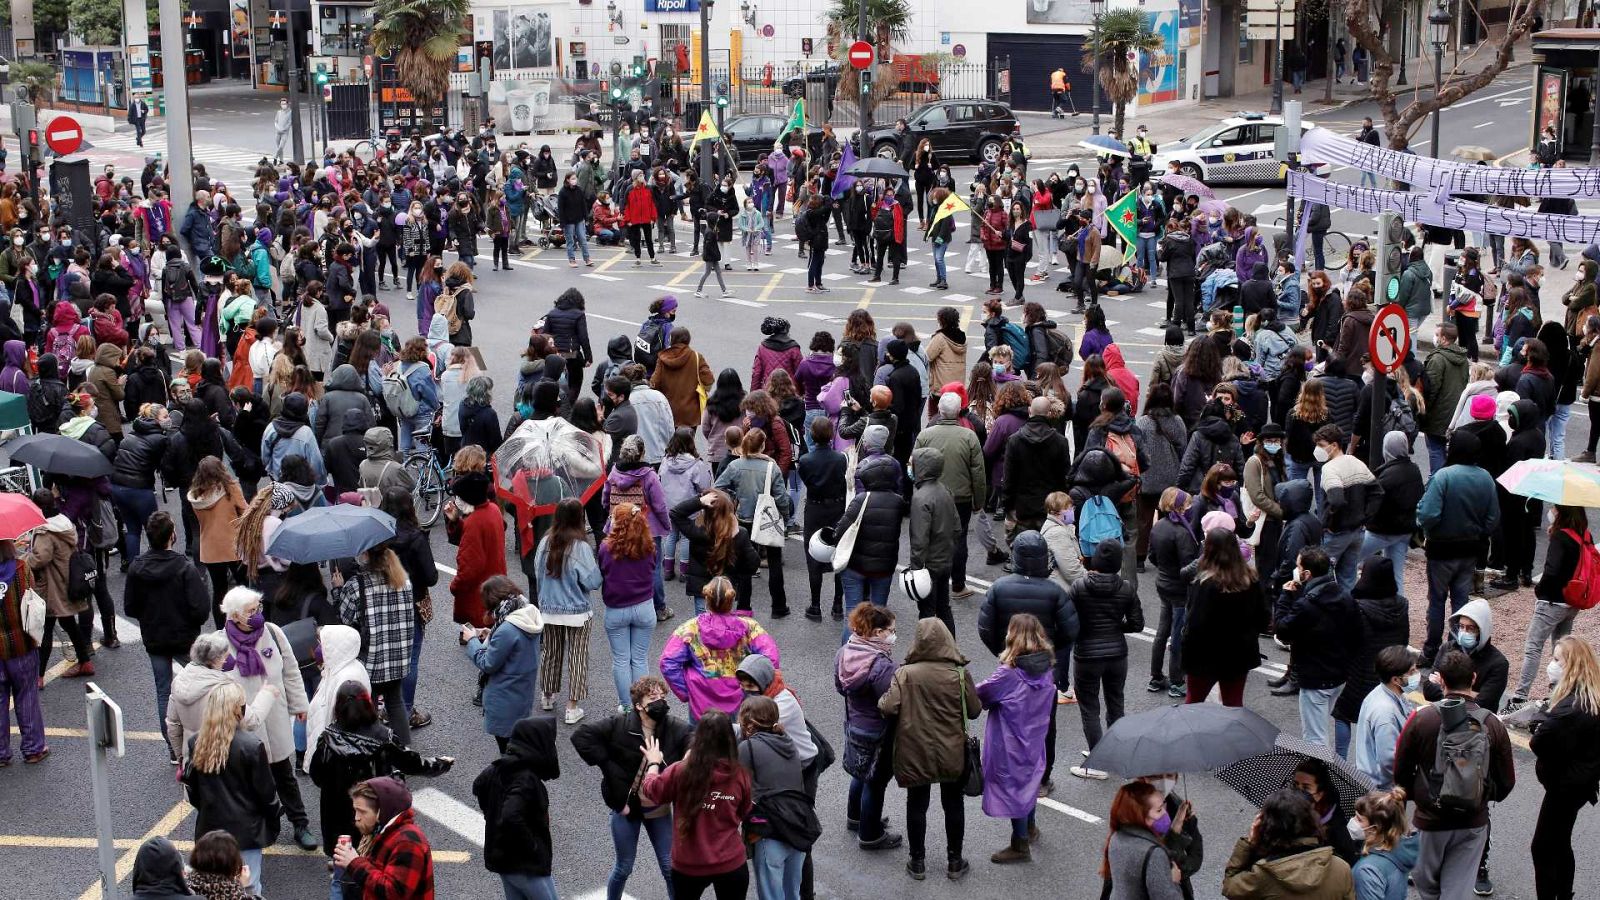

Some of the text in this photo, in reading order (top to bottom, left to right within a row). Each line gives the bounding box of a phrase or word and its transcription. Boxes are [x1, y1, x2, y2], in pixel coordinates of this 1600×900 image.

[657, 0, 686, 11] Ripoll
[1257, 150, 1274, 159] PL
[1350, 142, 1421, 182] DAVANT
[1567, 168, 1600, 197] SO
[1324, 180, 1428, 222] FEMINISME
